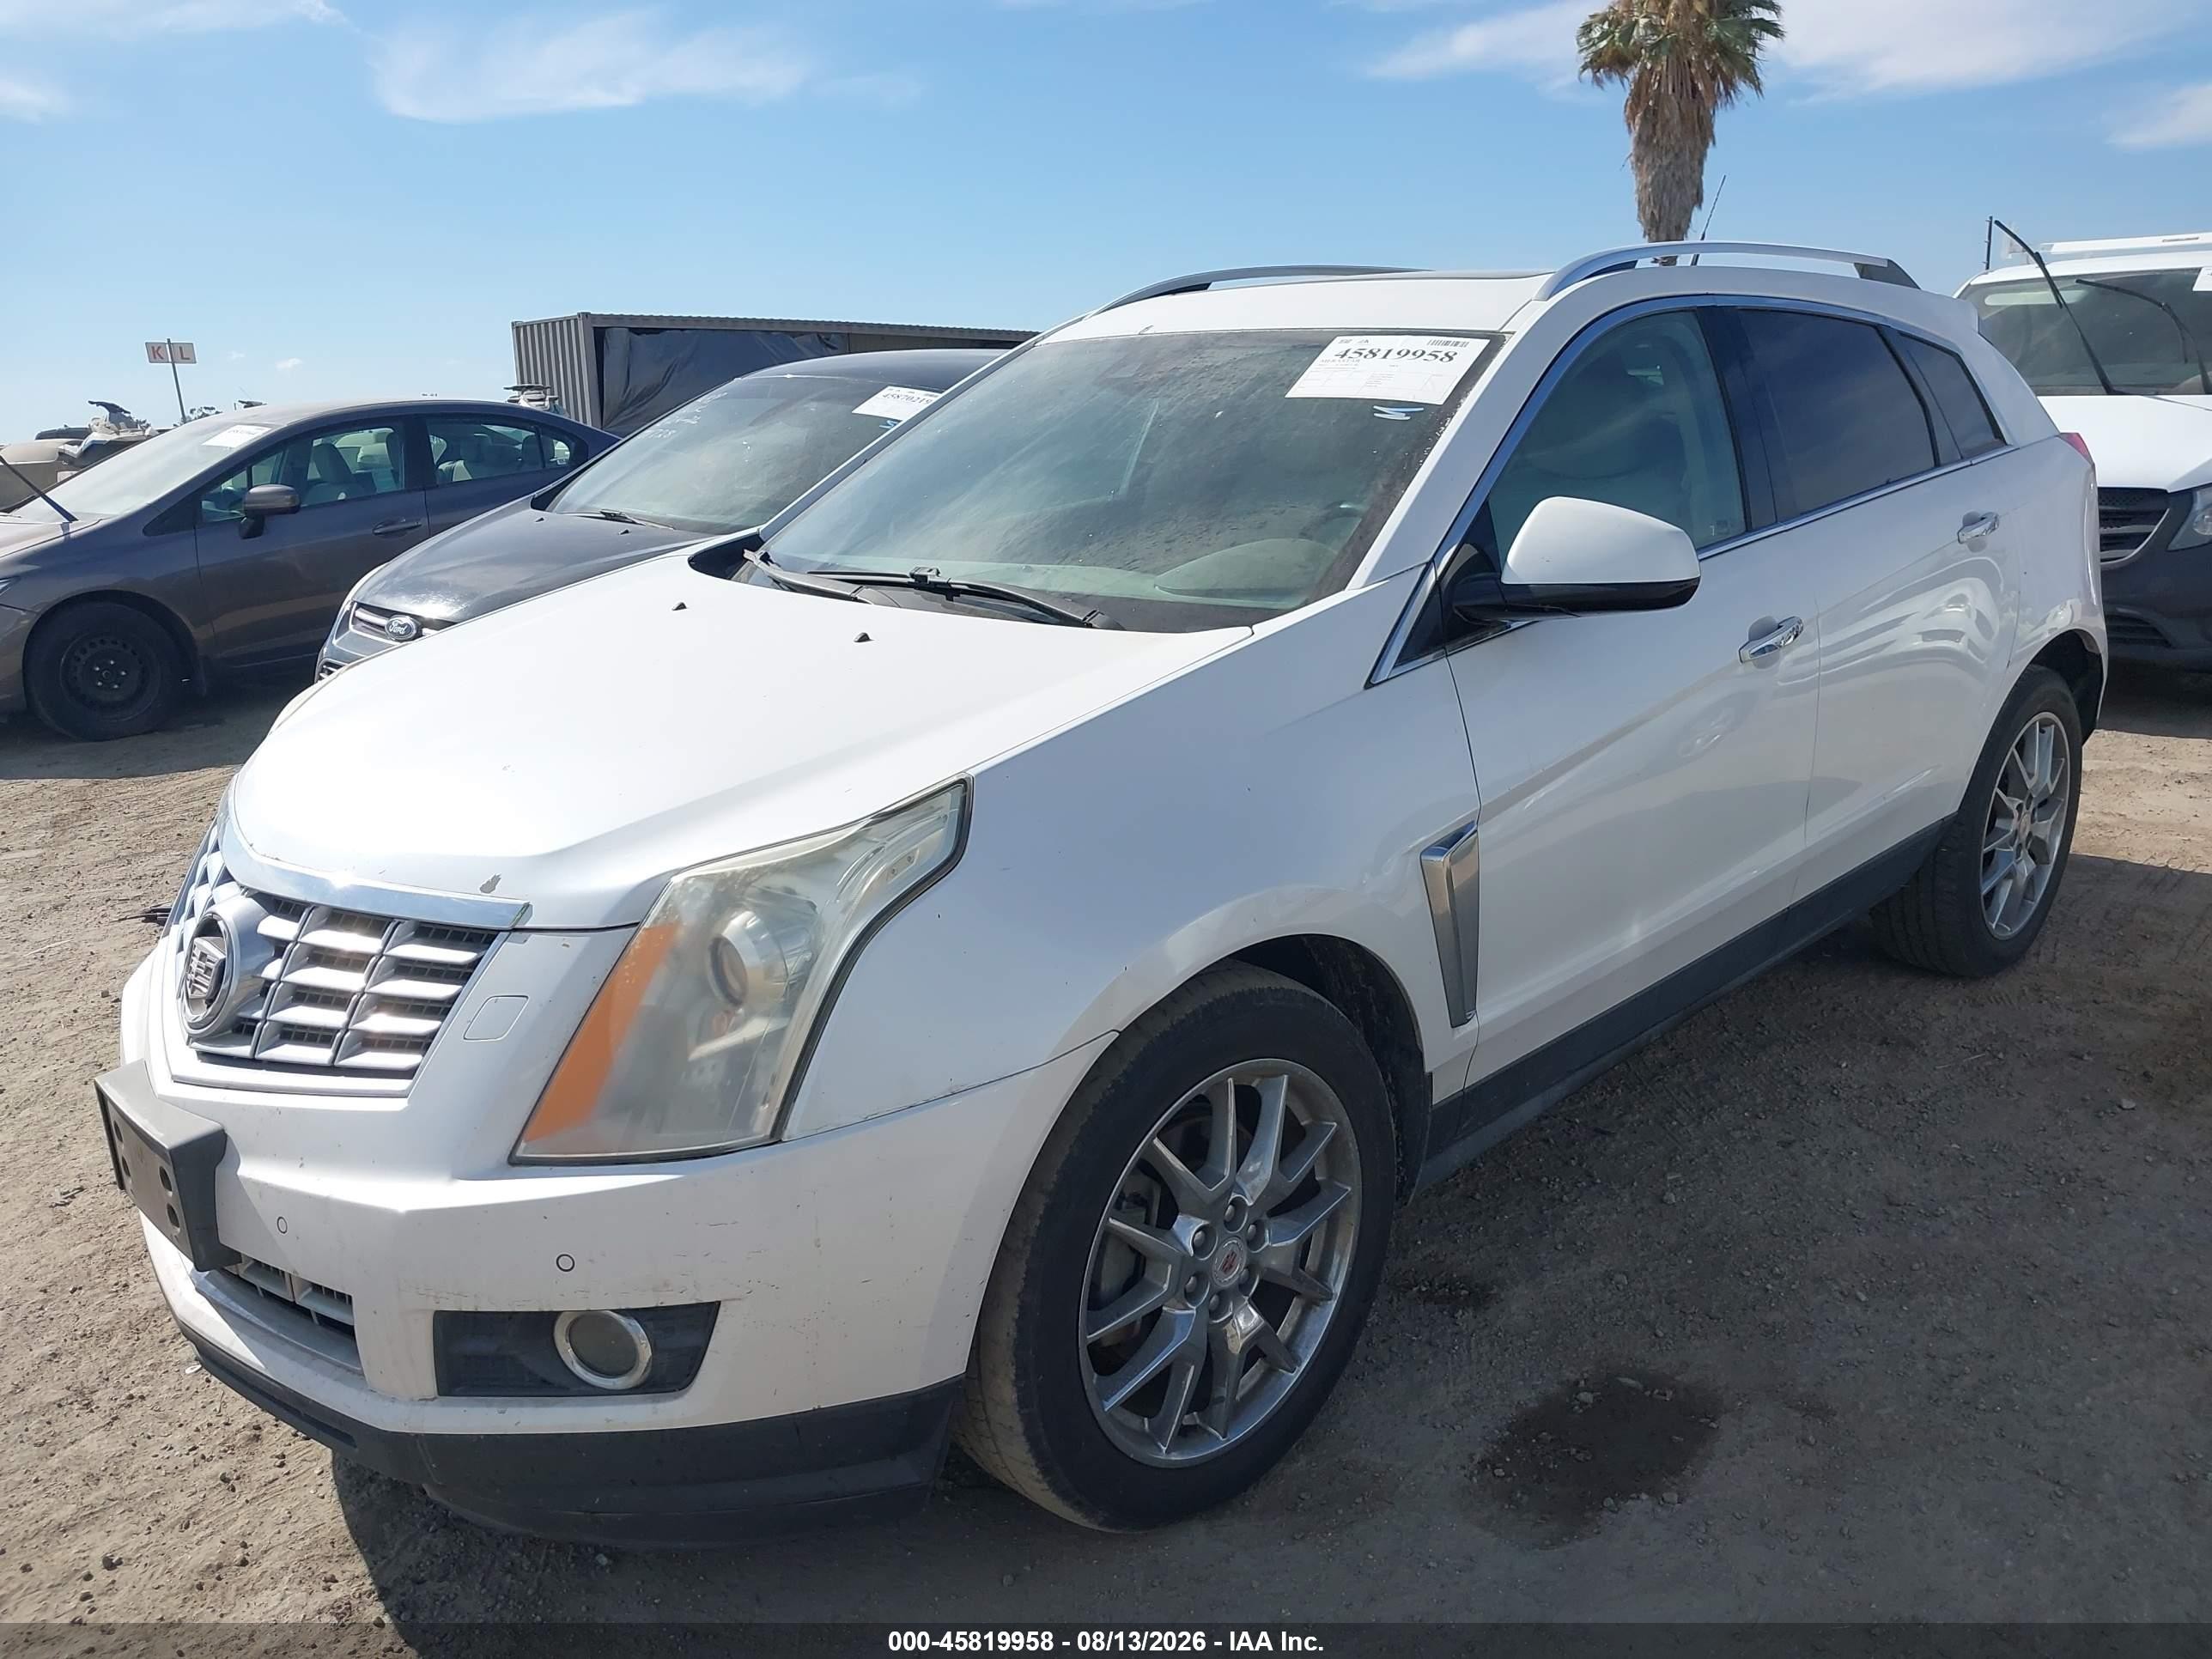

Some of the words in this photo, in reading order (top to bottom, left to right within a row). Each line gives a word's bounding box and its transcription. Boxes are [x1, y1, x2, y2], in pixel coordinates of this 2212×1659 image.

[151, 345, 164, 360] K
[179, 345, 191, 361] L
[1334, 347, 1458, 363] 45819958
[389, 619, 407, 635] Ford
